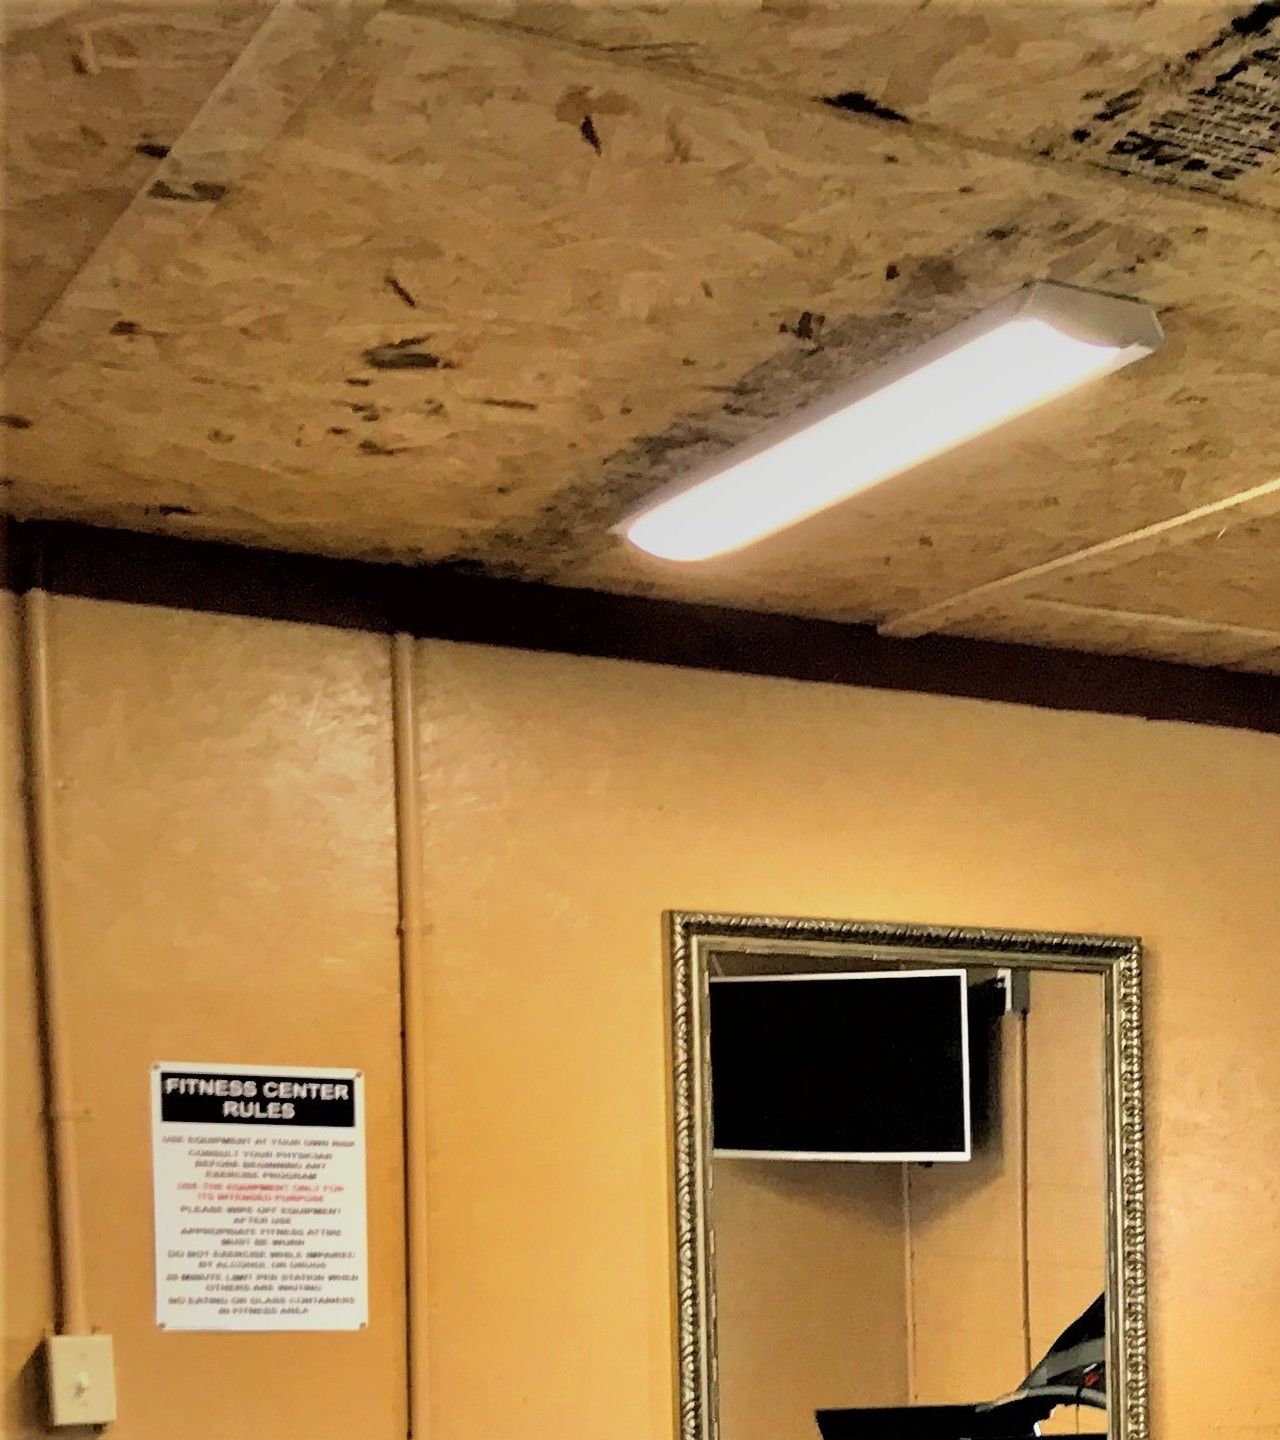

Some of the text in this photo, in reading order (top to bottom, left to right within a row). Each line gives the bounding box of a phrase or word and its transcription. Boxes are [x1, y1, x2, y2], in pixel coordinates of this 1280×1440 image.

[165, 1077, 350, 1101] FITNESS CENTER
[222, 1100, 296, 1120] RULES
